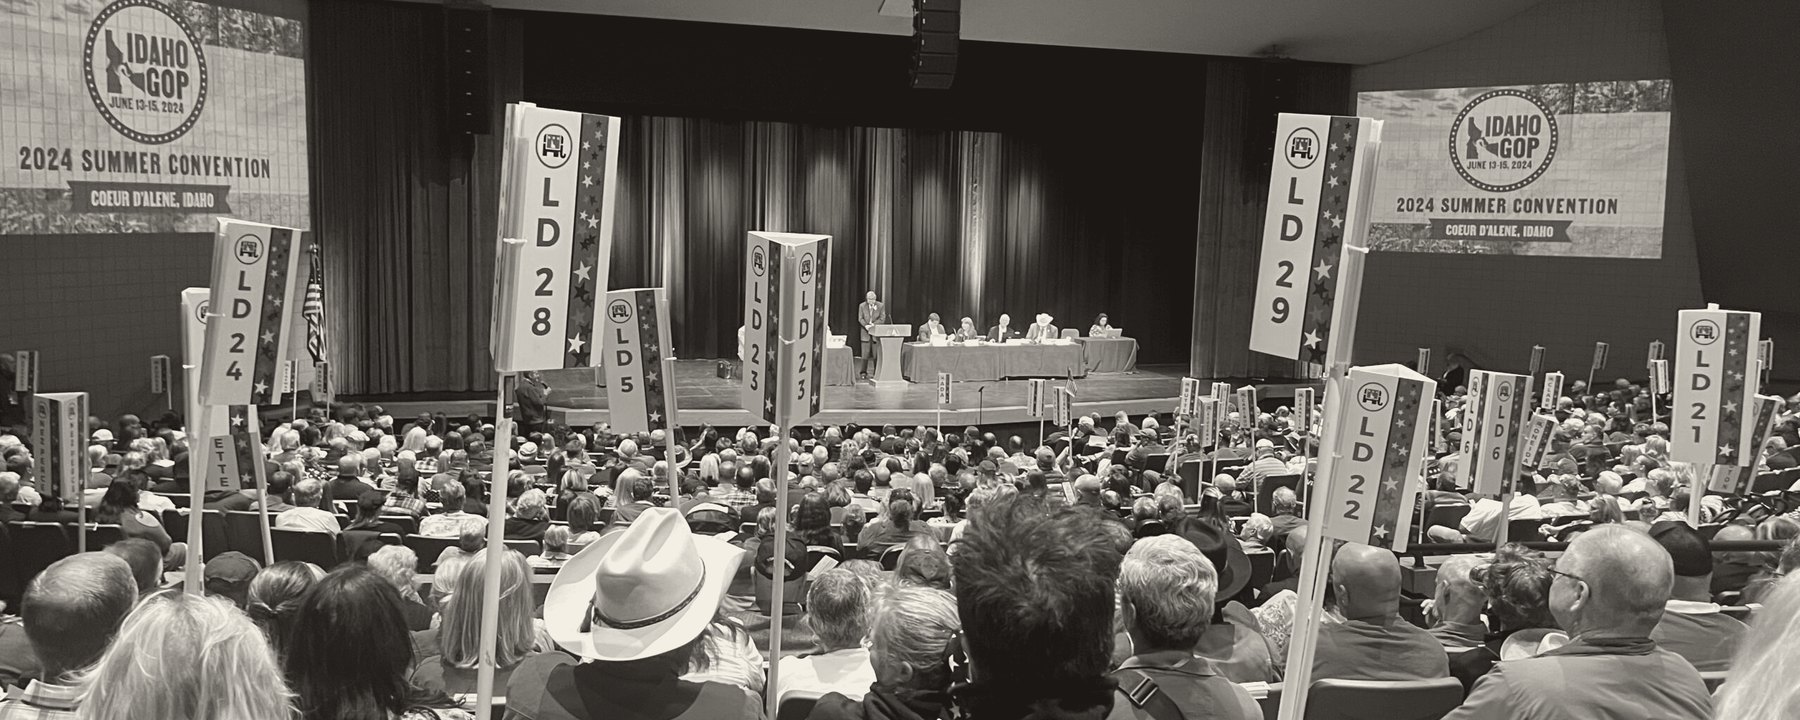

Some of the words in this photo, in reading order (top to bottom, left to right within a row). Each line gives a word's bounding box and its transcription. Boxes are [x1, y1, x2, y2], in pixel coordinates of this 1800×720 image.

[127, 32, 189, 69] IDAHO
[146, 67, 189, 99] GOP
[109, 96, 133, 110] JUNE
[136, 98, 159, 112] 13-15,
[162, 101, 184, 114] 2024
[1485, 115, 1541, 137] IDAHO
[19, 146, 72, 171] 2024
[82, 149, 161, 175] SUMMER
[169, 153, 271, 179] CONVENTION
[1467, 160, 1486, 170] JUNE
[1489, 160, 1509, 170] 13-15,
[1511, 160, 1532, 169] 2024
[1500, 137, 1540, 159] GOP
[91, 189, 129, 208] COEUR
[133, 190, 180, 209] D'ALENE,
[183, 192, 214, 208] IDAHO
[536, 177, 560, 248] LD
[1280, 177, 1304, 242] LD
[1396, 197, 1435, 213] 2024
[1441, 197, 1506, 214] SUMMER
[1512, 198, 1618, 215] CONVENTION
[1445, 224, 1477, 236] COEUR
[1479, 225, 1520, 238] D'ALENE,
[1523, 226, 1554, 237] IDAHO
[232, 270, 252, 319] LD
[531, 267, 554, 336] 28
[752, 281, 762, 331] LD
[1271, 260, 1294, 324] 29
[799, 290, 809, 340] LD
[226, 332, 245, 381] 24
[616, 328, 633, 368] LD
[621, 376, 634, 393] 5
[750, 343, 760, 391] 23
[797, 352, 806, 400] 23
[1691, 350, 1711, 391] LD
[1466, 400, 1474, 432] LD
[1494, 405, 1505, 438] LD
[1690, 402, 1706, 443] 21
[1352, 416, 1374, 463] LD
[1464, 441, 1470, 454] 6
[1492, 447, 1500, 460] 6
[1522, 428, 1540, 464] ONEIDA
[1343, 474, 1365, 521] 22
